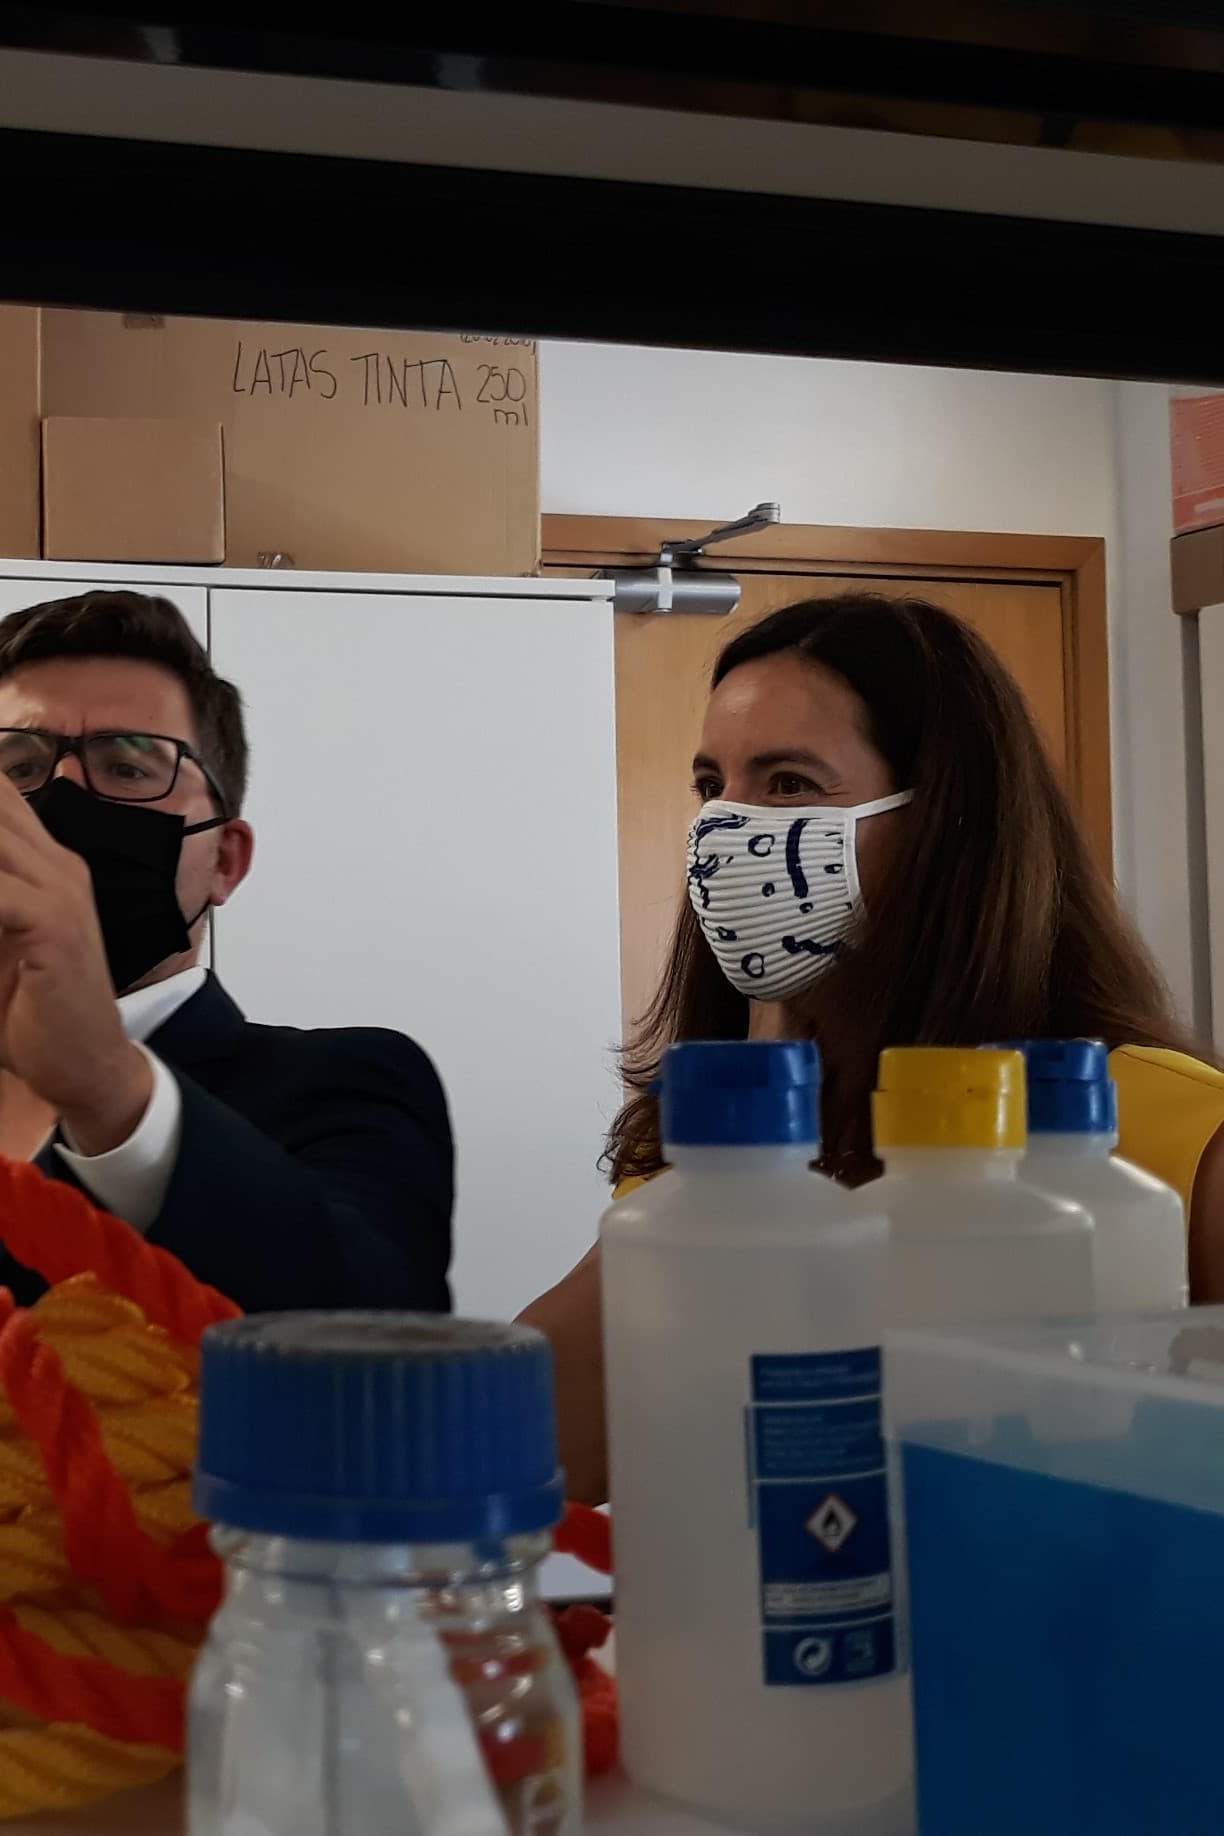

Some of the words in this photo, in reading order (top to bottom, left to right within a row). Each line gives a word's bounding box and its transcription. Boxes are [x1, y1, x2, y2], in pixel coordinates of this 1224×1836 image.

[232, 341, 337, 399] LATAS
[350, 352, 462, 410] TINTA
[475, 364, 526, 403] 250
[493, 403, 528, 426] ml
